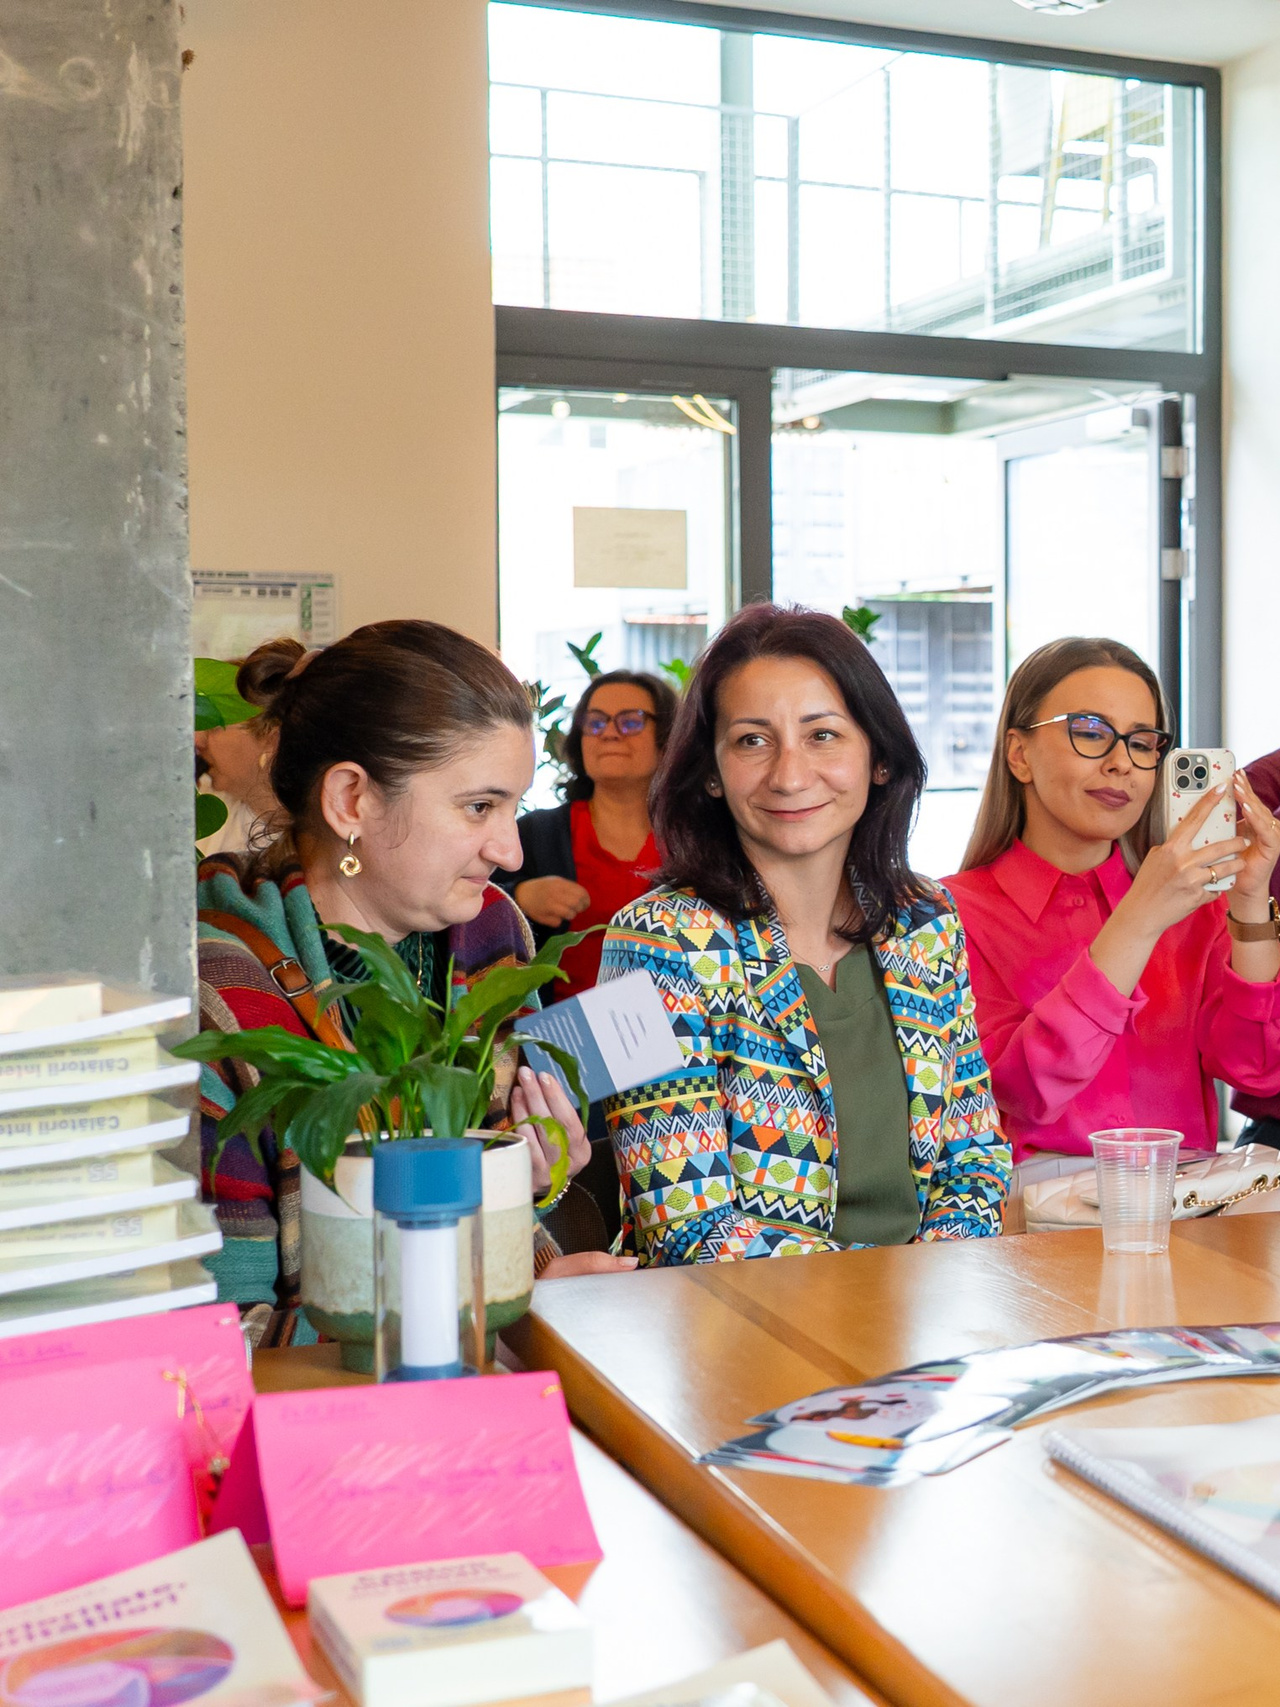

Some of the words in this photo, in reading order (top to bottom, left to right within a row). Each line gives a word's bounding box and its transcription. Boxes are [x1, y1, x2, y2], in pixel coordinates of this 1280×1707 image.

[47, 1057, 129, 1077] Călătorii
[38, 1116, 120, 1136] Călătorii
[87, 1161, 119, 1182] 55
[112, 1215, 144, 1237] 55
